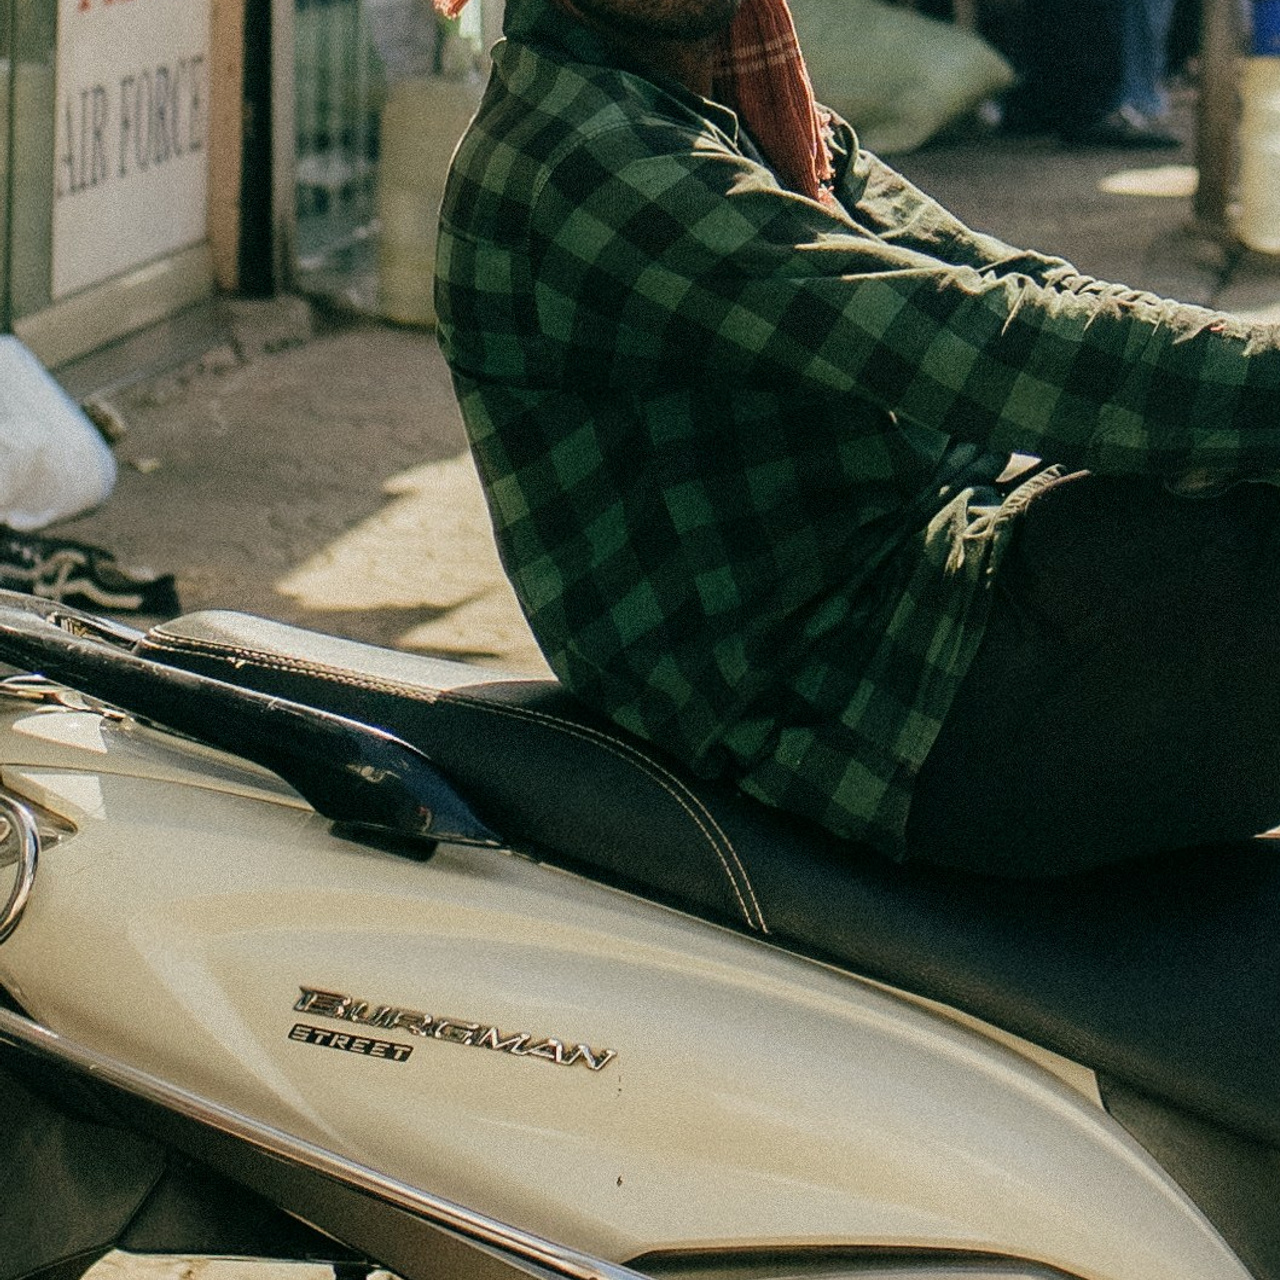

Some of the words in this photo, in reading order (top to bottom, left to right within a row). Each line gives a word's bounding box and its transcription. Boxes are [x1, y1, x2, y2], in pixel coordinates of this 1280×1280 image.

[54, 84, 108, 198] AIR
[115, 54, 204, 178] FORCE
[289, 1023, 413, 1062] STREET
[293, 985, 616, 1071] BURGMAN
